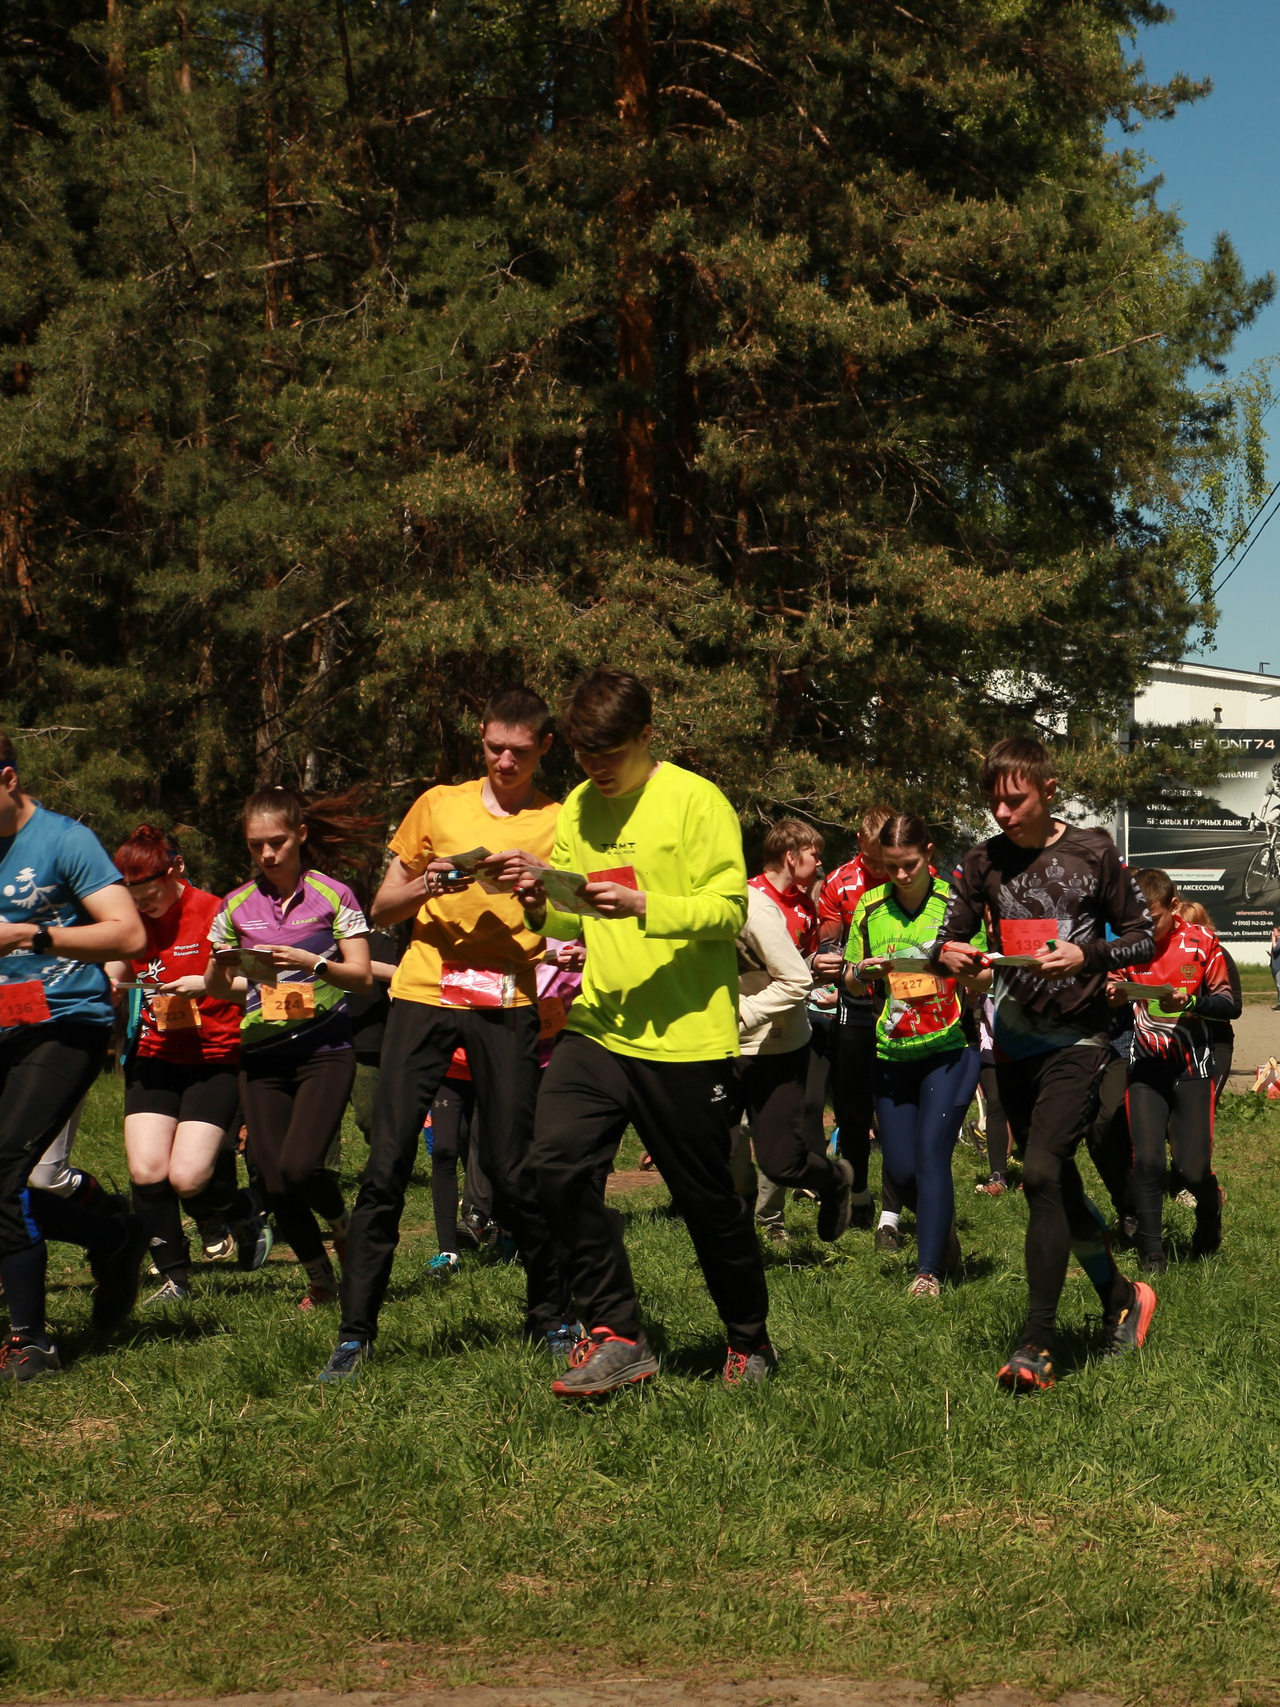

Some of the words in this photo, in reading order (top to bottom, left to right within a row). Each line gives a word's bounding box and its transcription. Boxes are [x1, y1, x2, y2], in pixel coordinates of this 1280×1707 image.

[1222, 819, 1242, 827] ЛЫЖ
[291, 916, 319, 926] LEADER
[886, 943, 896, 954] N
[1015, 939, 1041, 951] 139
[901, 979, 923, 990] 227
[7, 1002, 34, 1016] 136
[275, 1000, 300, 1010] 224
[164, 1010, 186, 1022] 223
